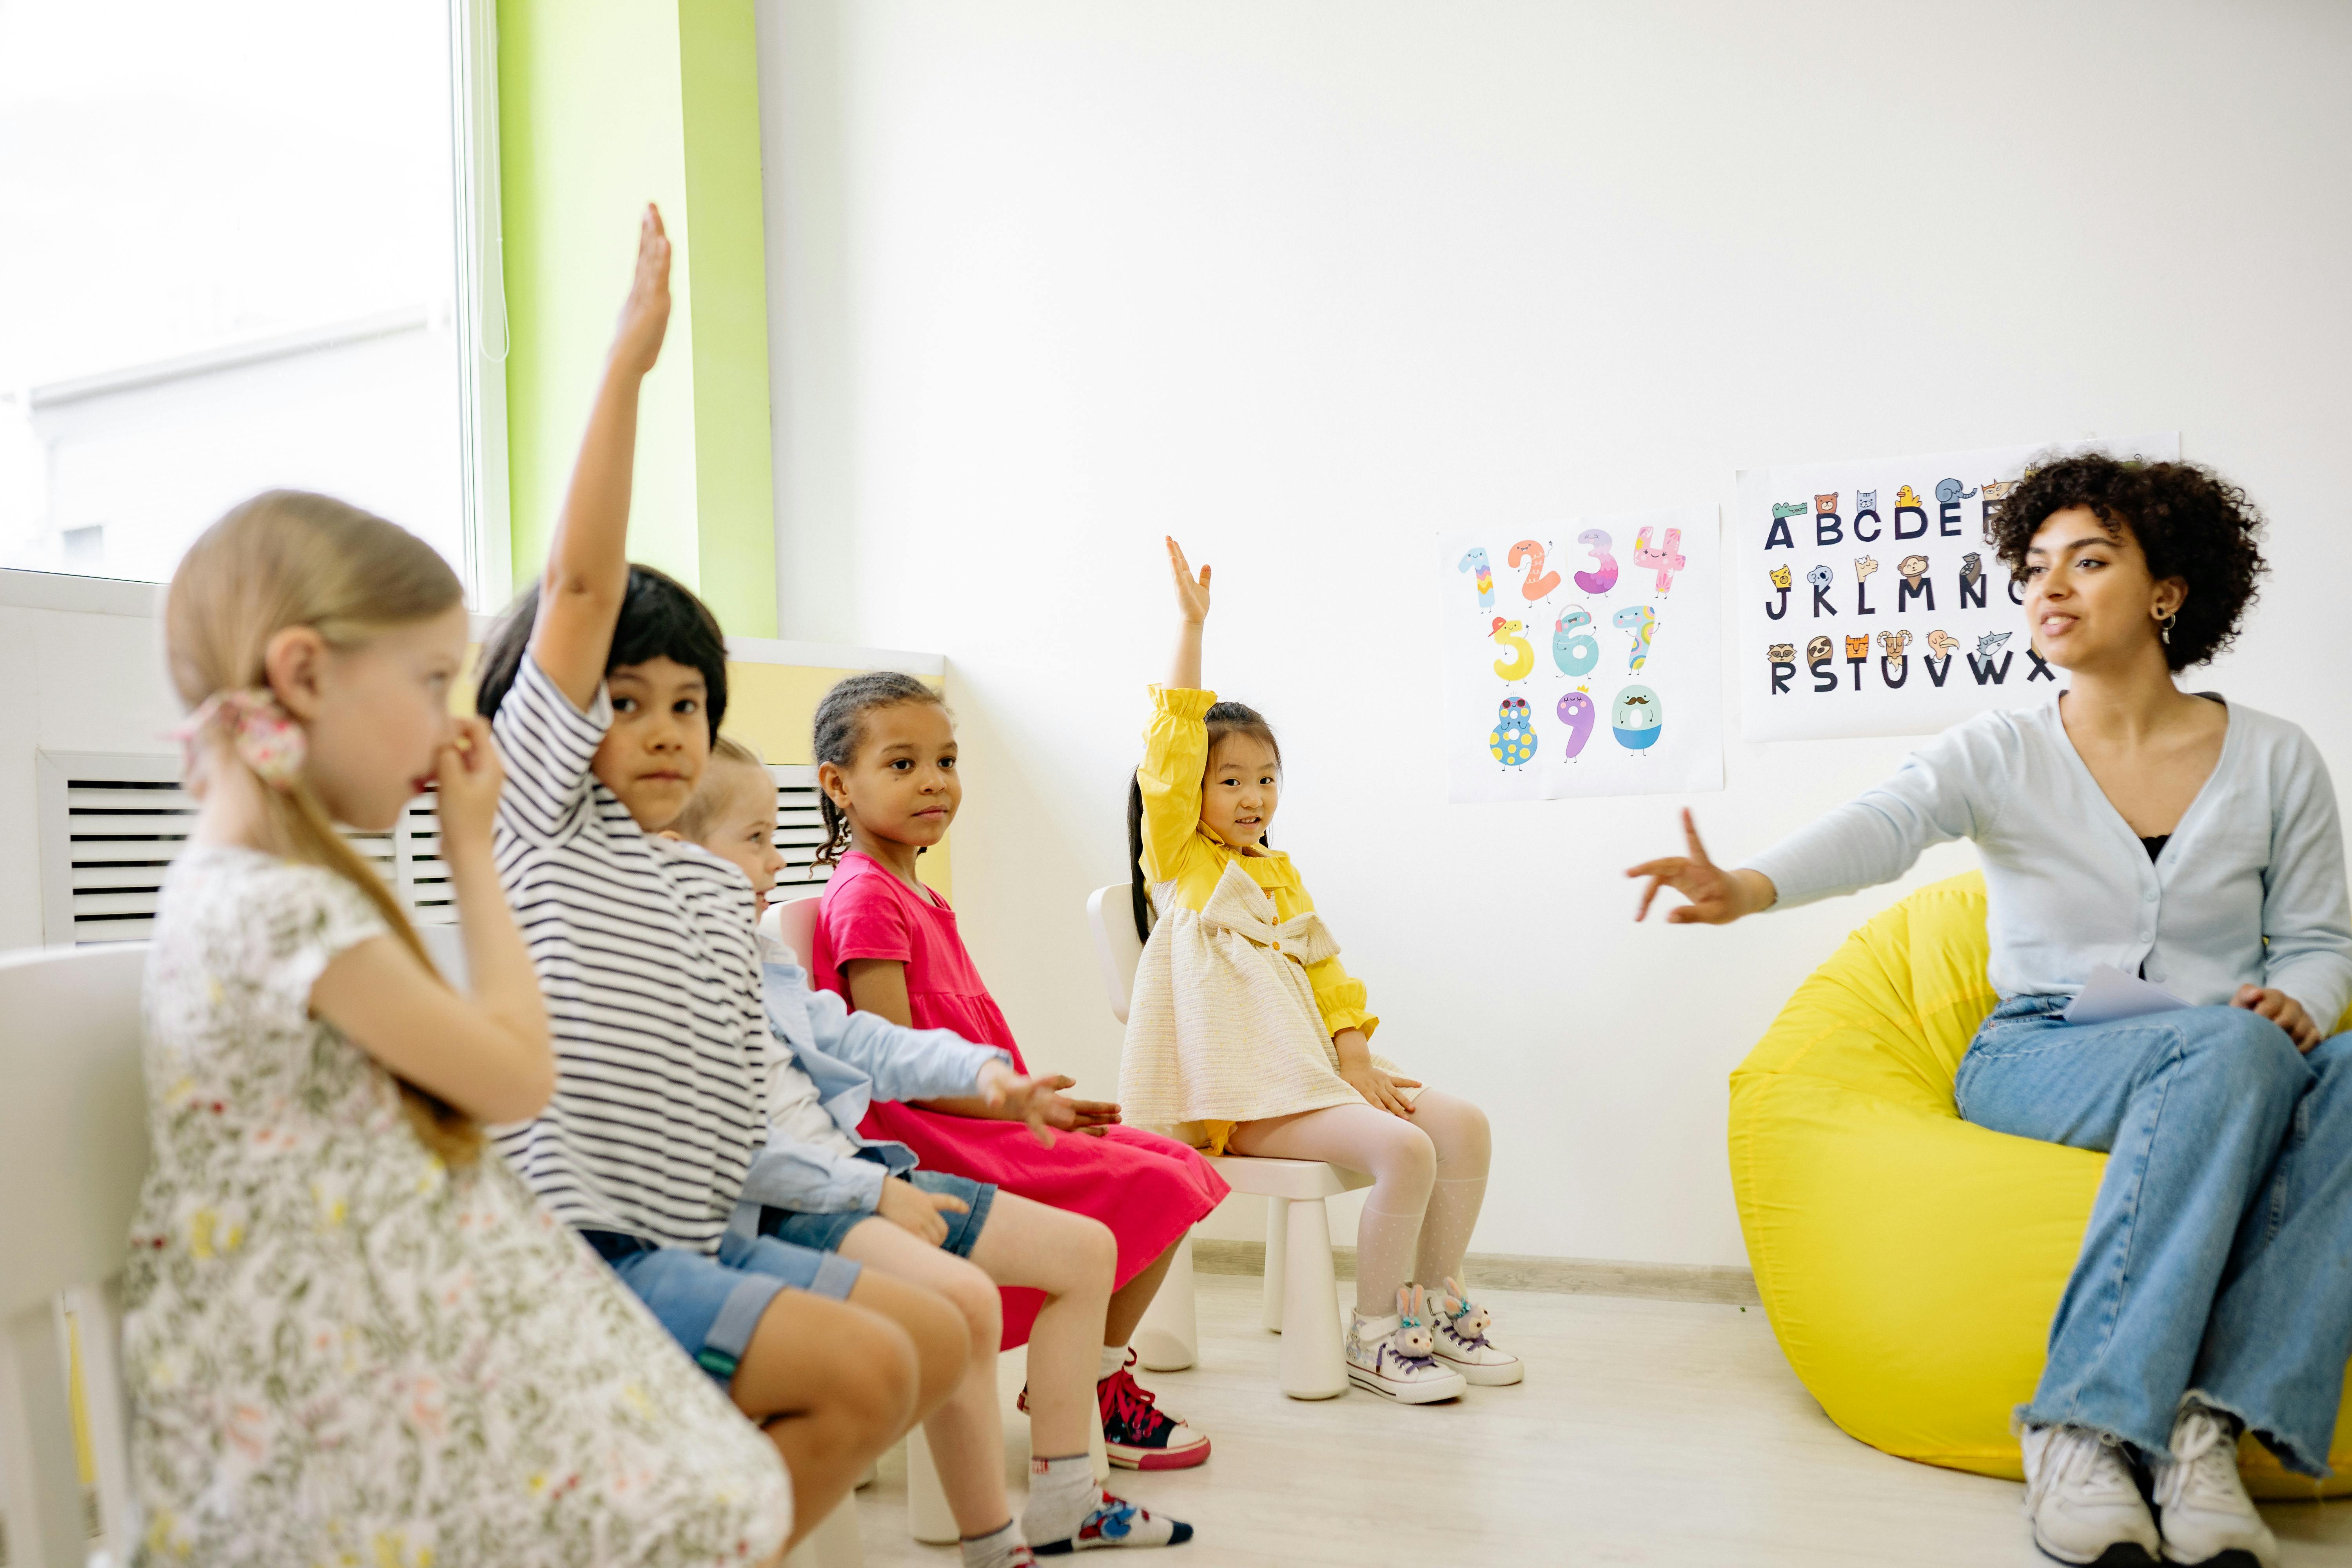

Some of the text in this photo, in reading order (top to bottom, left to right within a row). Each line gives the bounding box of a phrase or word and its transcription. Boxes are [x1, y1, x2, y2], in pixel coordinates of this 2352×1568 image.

[1764, 517, 1795, 550] A
[1817, 513, 1843, 546] B
[1854, 509, 1881, 542] C
[1895, 506, 1927, 539] D
[1940, 502, 1962, 536] E
[1458, 526, 1686, 608] 1 2 3 4
[1766, 588, 1791, 620] J
[1813, 585, 1838, 617] K
[1858, 582, 1875, 615] L
[1898, 577, 1935, 612] M
[1960, 574, 1987, 608] N
[1494, 606, 1655, 681] 5 6 7
[1771, 648, 2057, 695] R S T U V W X
[1490, 684, 1662, 766] 8 9 0
